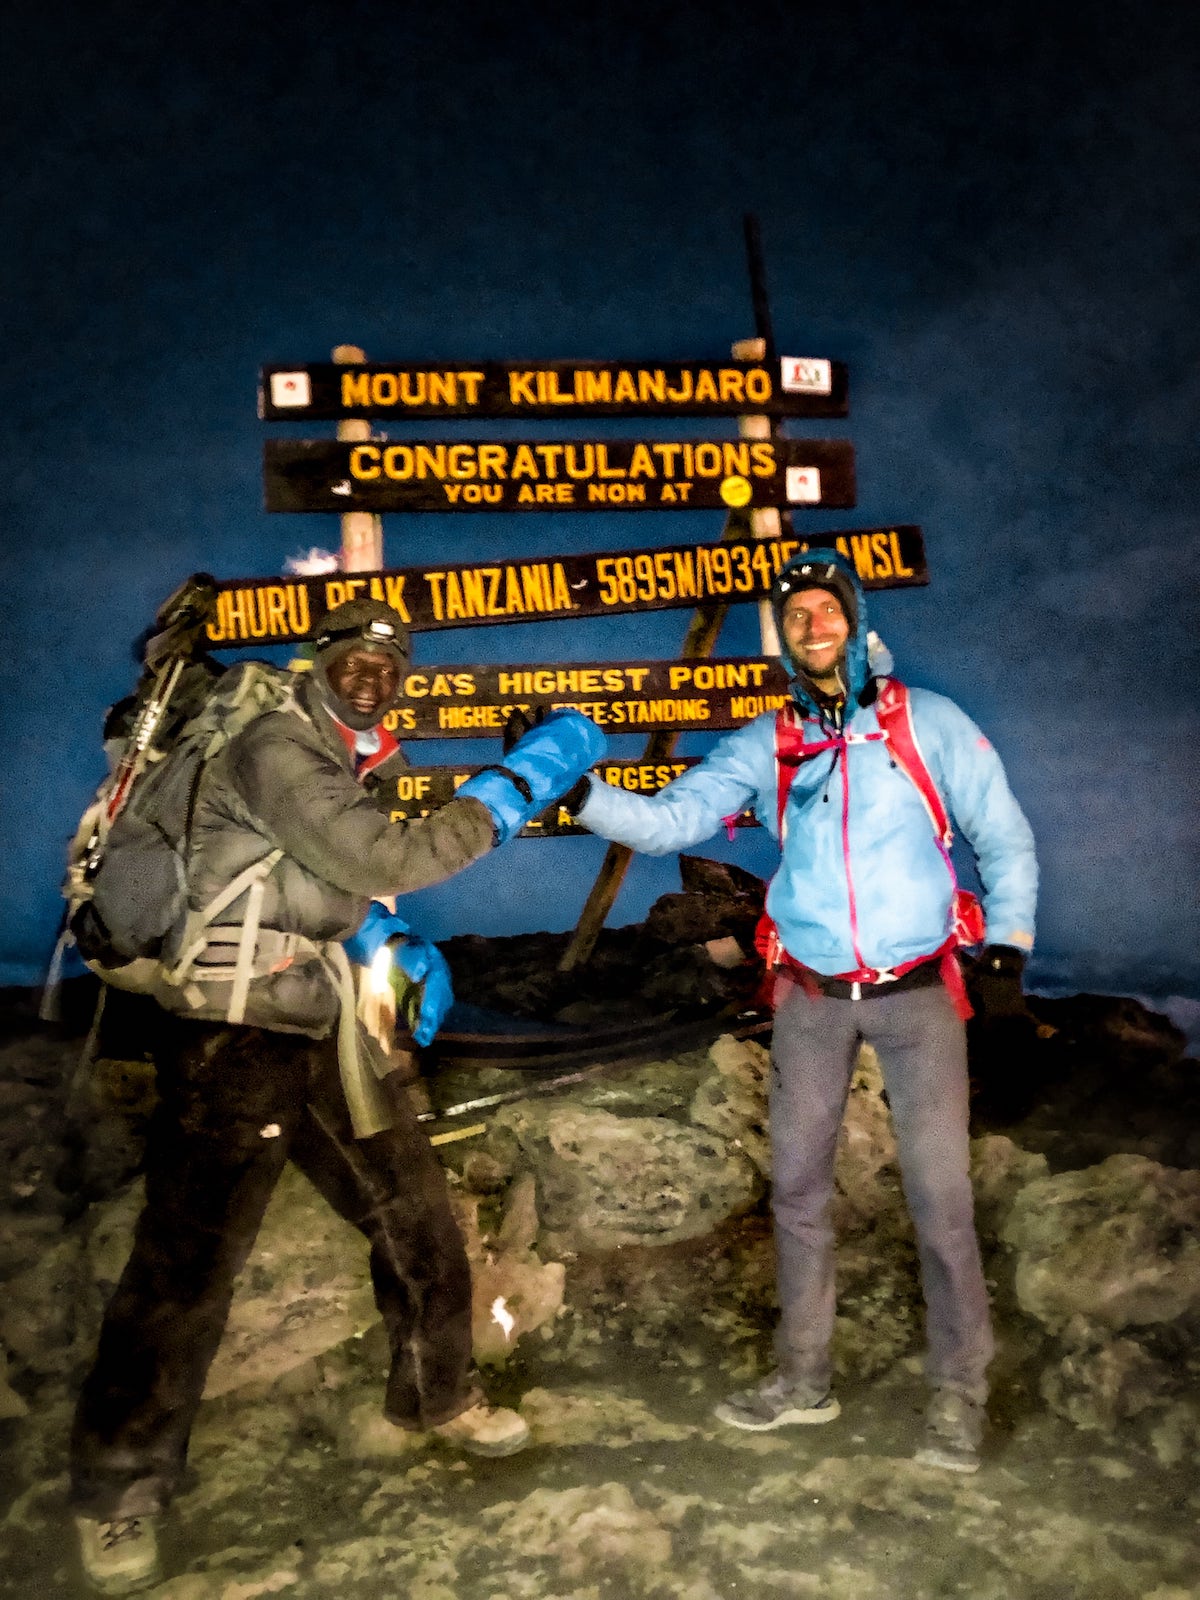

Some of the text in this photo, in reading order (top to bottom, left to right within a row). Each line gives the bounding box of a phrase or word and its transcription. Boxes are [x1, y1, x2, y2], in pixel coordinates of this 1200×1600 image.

[341, 371, 485, 406] MOUNT
[508, 367, 772, 404] KILIMANJARO
[350, 444, 777, 479] CONGRATULATIONS
[443, 483, 503, 503] YOU
[517, 483, 575, 502] ARE
[660, 482, 693, 502] AT
[498, 668, 650, 694] HIGHEST
[668, 663, 769, 691] POINT
[397, 775, 432, 801] OF
